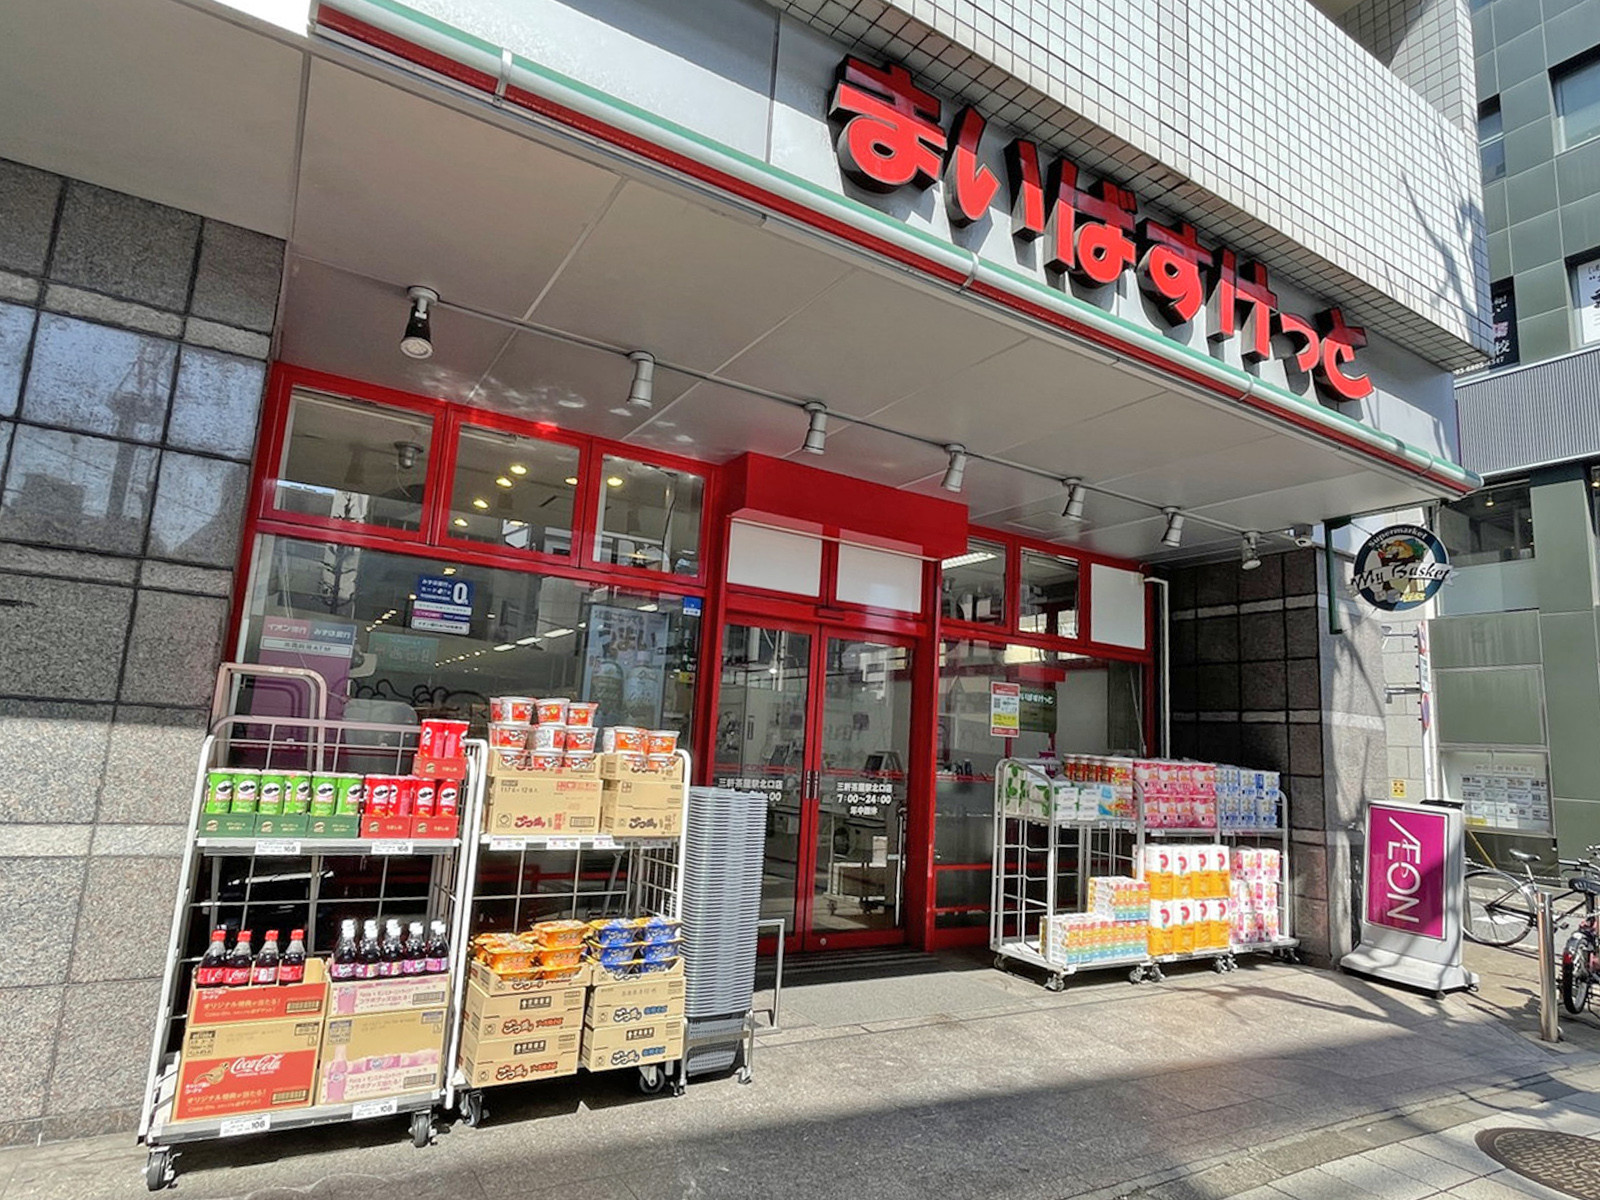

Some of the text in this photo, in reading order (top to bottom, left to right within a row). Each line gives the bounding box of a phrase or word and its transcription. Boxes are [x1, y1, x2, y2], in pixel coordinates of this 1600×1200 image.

[829, 54, 1374, 402] まいばすけっと
[1368, 526, 1428, 547] Supermarket
[1350, 562, 1450, 589] My Basket
[836, 782, 893, 793] 三軒茶屋駅北口店
